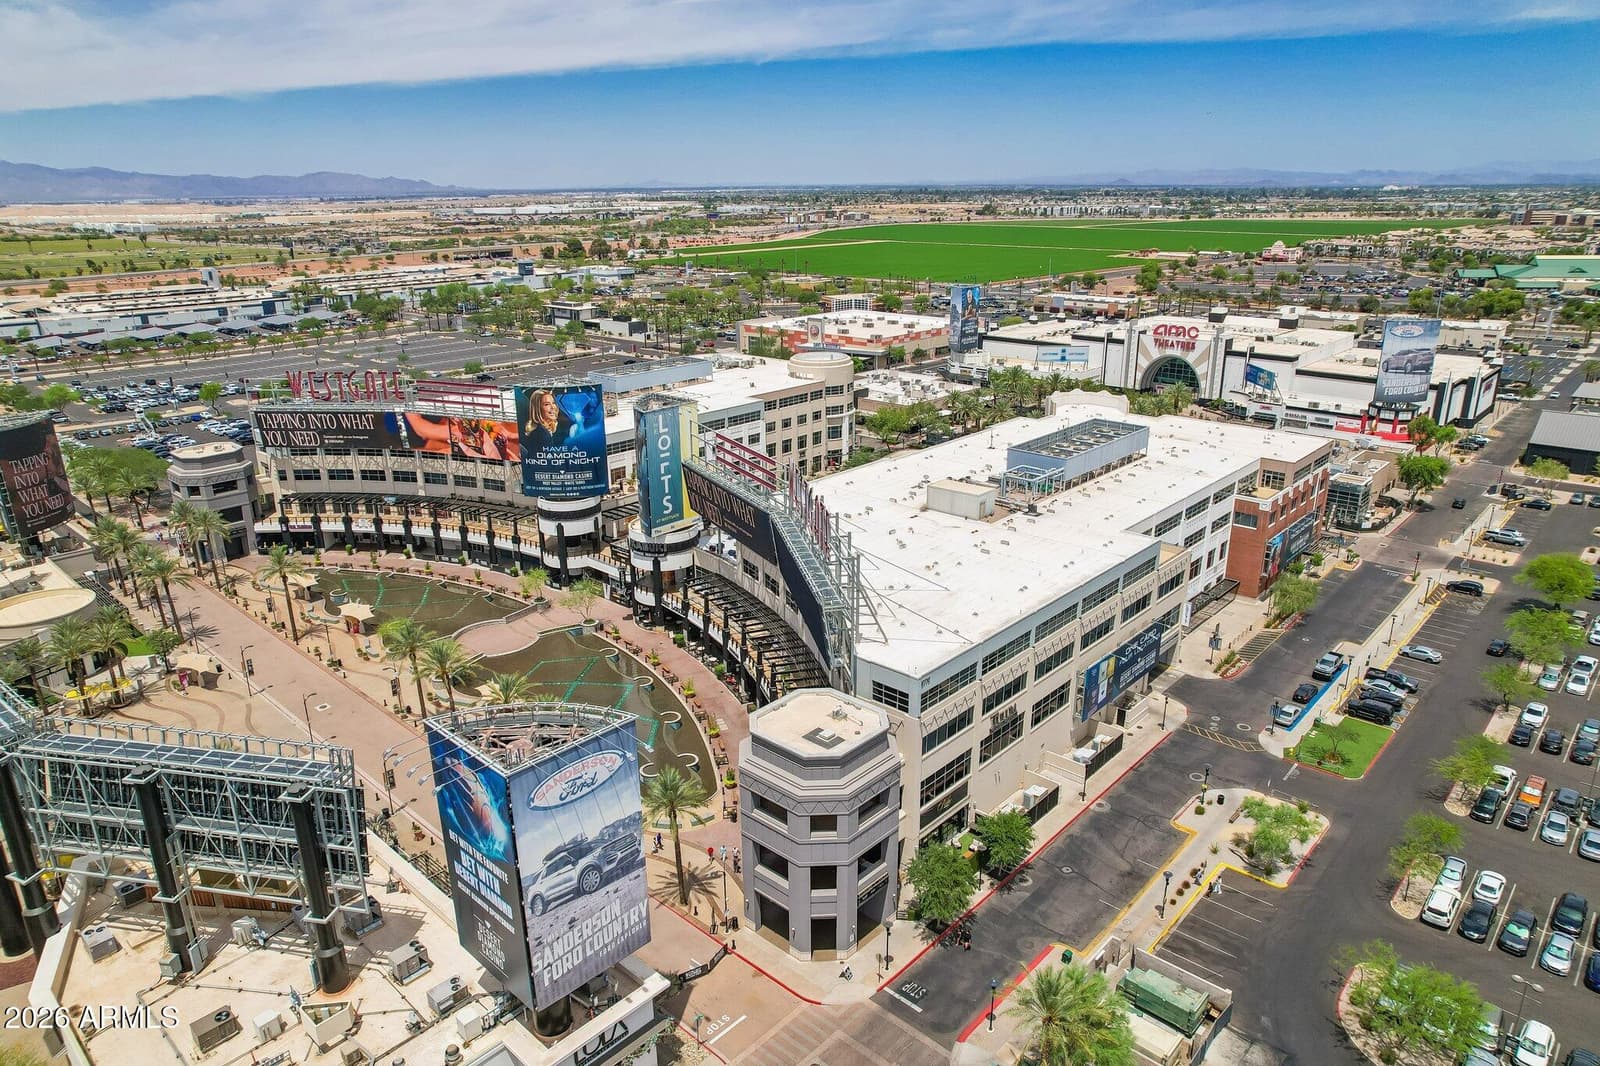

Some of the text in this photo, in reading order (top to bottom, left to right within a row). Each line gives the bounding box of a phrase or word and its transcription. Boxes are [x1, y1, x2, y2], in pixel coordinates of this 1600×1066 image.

[1153, 337, 1196, 351] THEATRES
[285, 369, 406, 402] WESTGATE
[257, 413, 375, 430] TAPPING INTO WHAT
[263, 430, 320, 447] YOU NEED
[9, 452, 49, 474] TAPPING
[525, 458, 548, 466] KIND
[569, 456, 601, 465] NIGHT
[536, 451, 587, 459] DIAMOND
[657, 414, 673, 515] LOFTS
[14, 471, 40, 489] INTO
[17, 484, 48, 504] WHAT
[22, 501, 44, 518] YOU
[44, 494, 65, 512] NEED
[729, 494, 756, 528] WHAT
[535, 756, 618, 801] SANDERSON
[559, 771, 599, 801] Ford
[476, 862, 500, 896] WITH
[532, 898, 621, 973] SANDERSON
[543, 898, 649, 987] FORD COUNTRY
[901, 982, 927, 999] STOP
[706, 1014, 731, 1035] STOP
